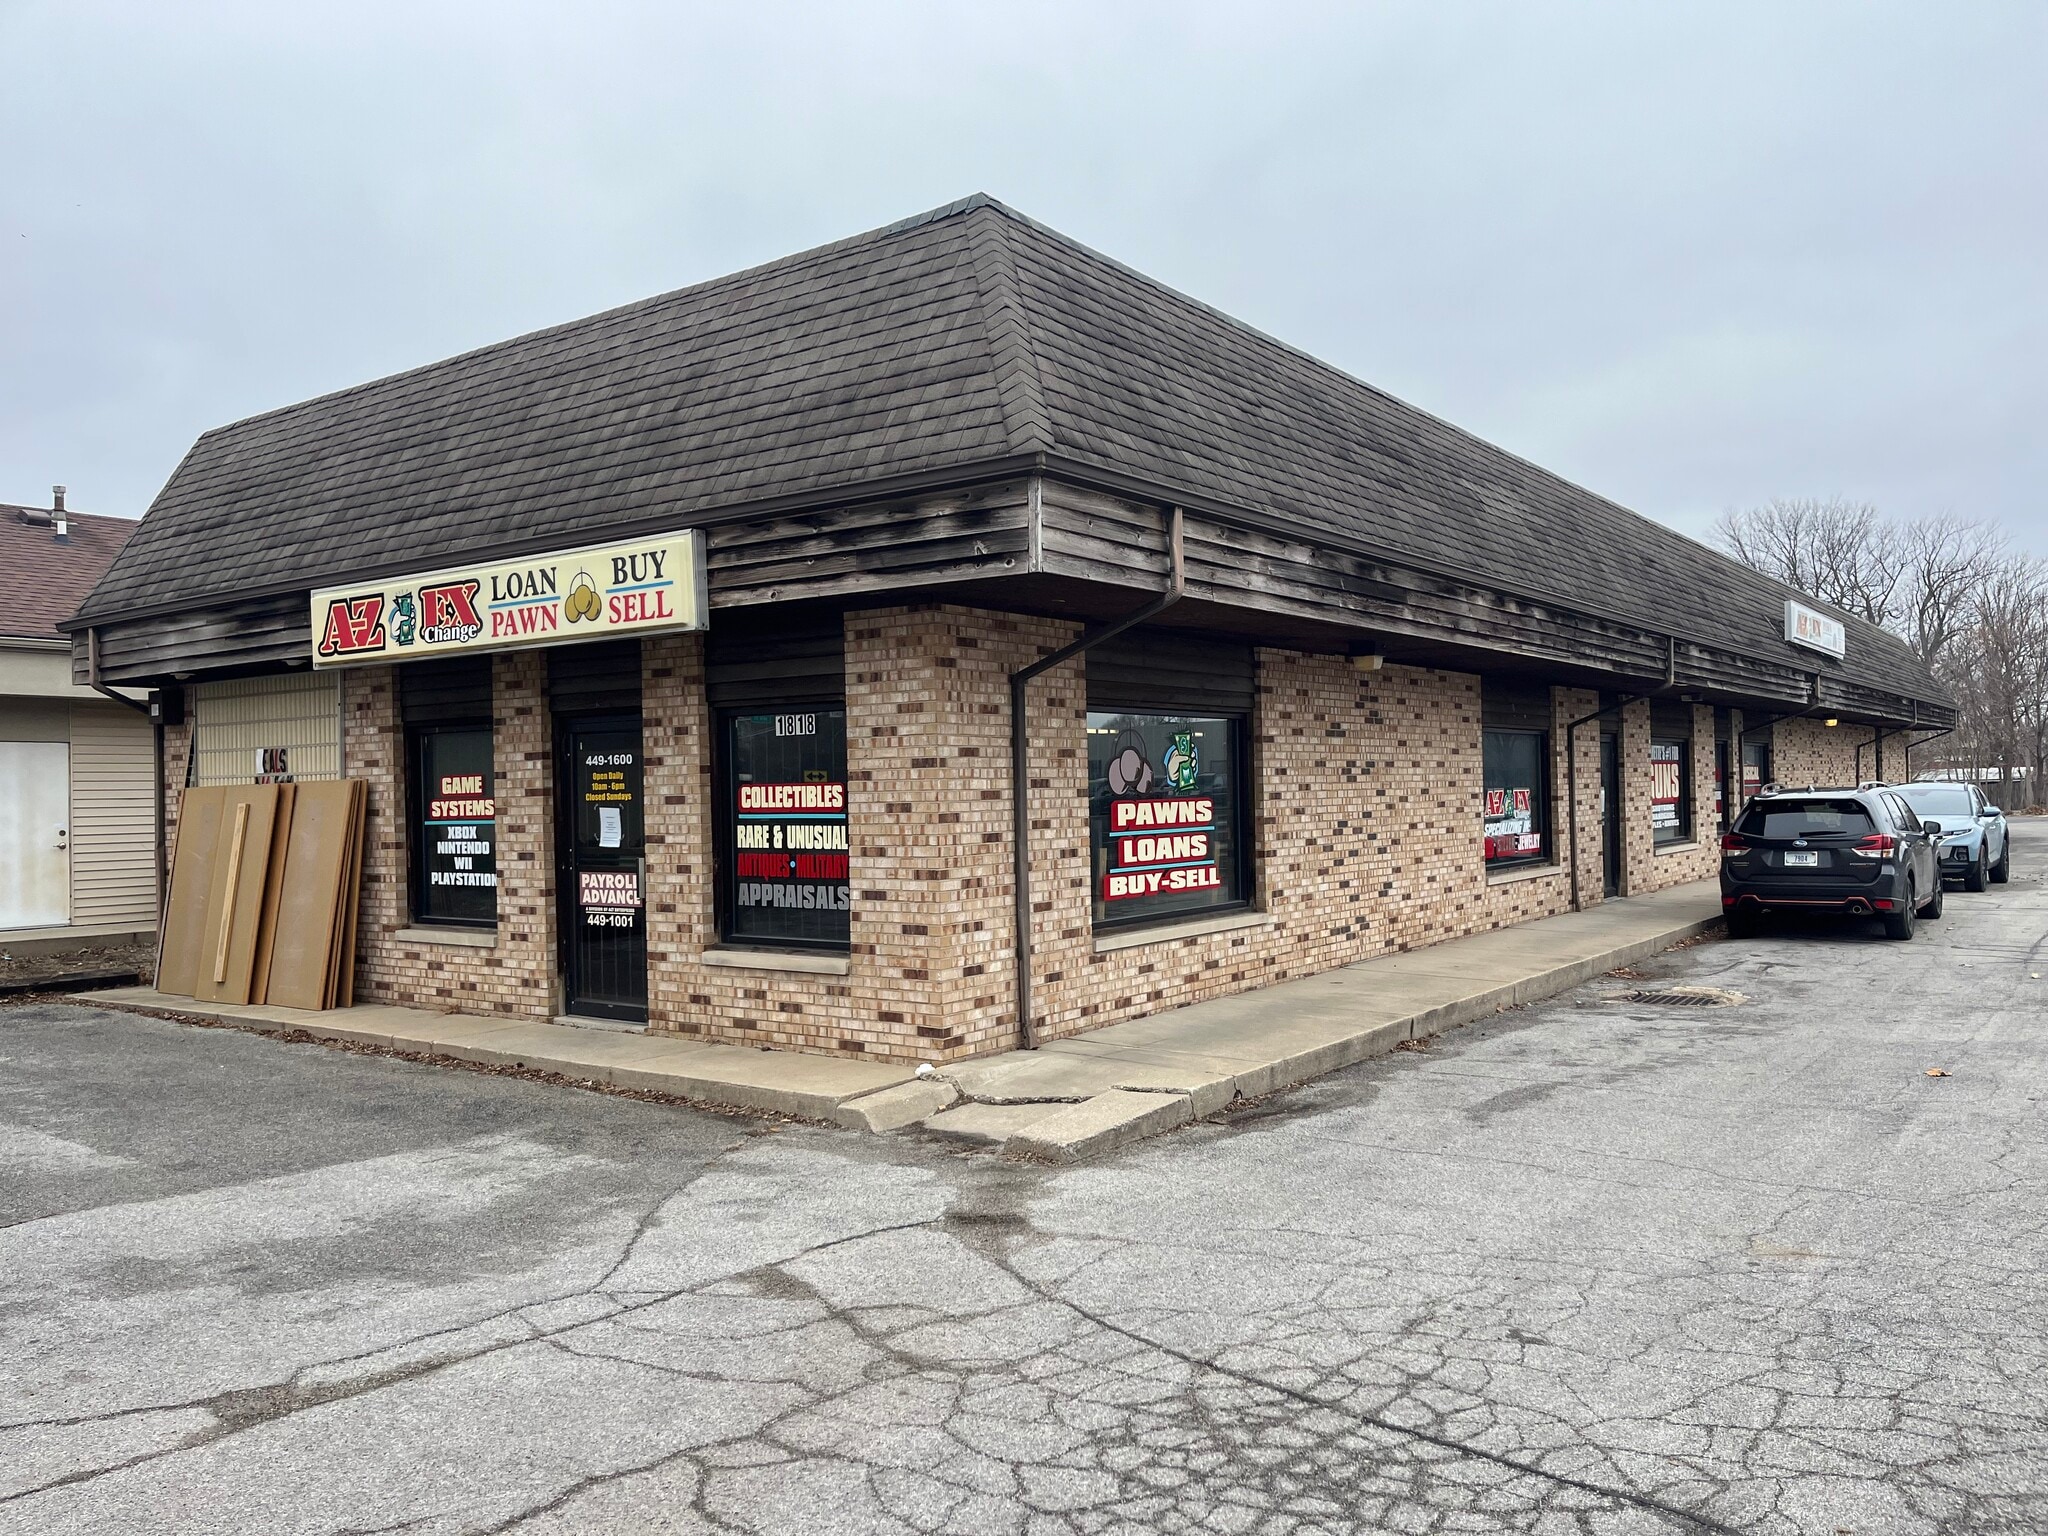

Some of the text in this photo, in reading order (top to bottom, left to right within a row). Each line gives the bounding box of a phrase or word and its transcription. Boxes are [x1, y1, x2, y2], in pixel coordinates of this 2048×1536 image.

[491, 550, 668, 601] LOAN BUY
[491, 590, 674, 638] PAWN SELL
[424, 624, 478, 643] Change
[777, 714, 814, 735] 1818
[585, 754, 633, 766] 449-1600
[441, 775, 483, 795] GAME
[592, 771, 624, 781] Open Daily
[585, 792, 632, 801] Closed Sundays
[741, 785, 843, 808] COLLECTIBLES
[431, 799, 495, 817] SYSTEMS
[1117, 800, 1212, 827] PAWNS
[447, 826, 477, 839] XBOX
[737, 825, 848, 850] RARE & UNUSUAL
[1518, 833, 1541, 851] JEWELRY
[437, 841, 490, 855] NINTENDO
[1123, 834, 1207, 864] LOANS
[454, 857, 473, 870] WII
[737, 853, 849, 881] ANTIQUES MILITARY
[1109, 867, 1221, 897] BUY-SELL
[738, 883, 850, 911] APPRAISALS
